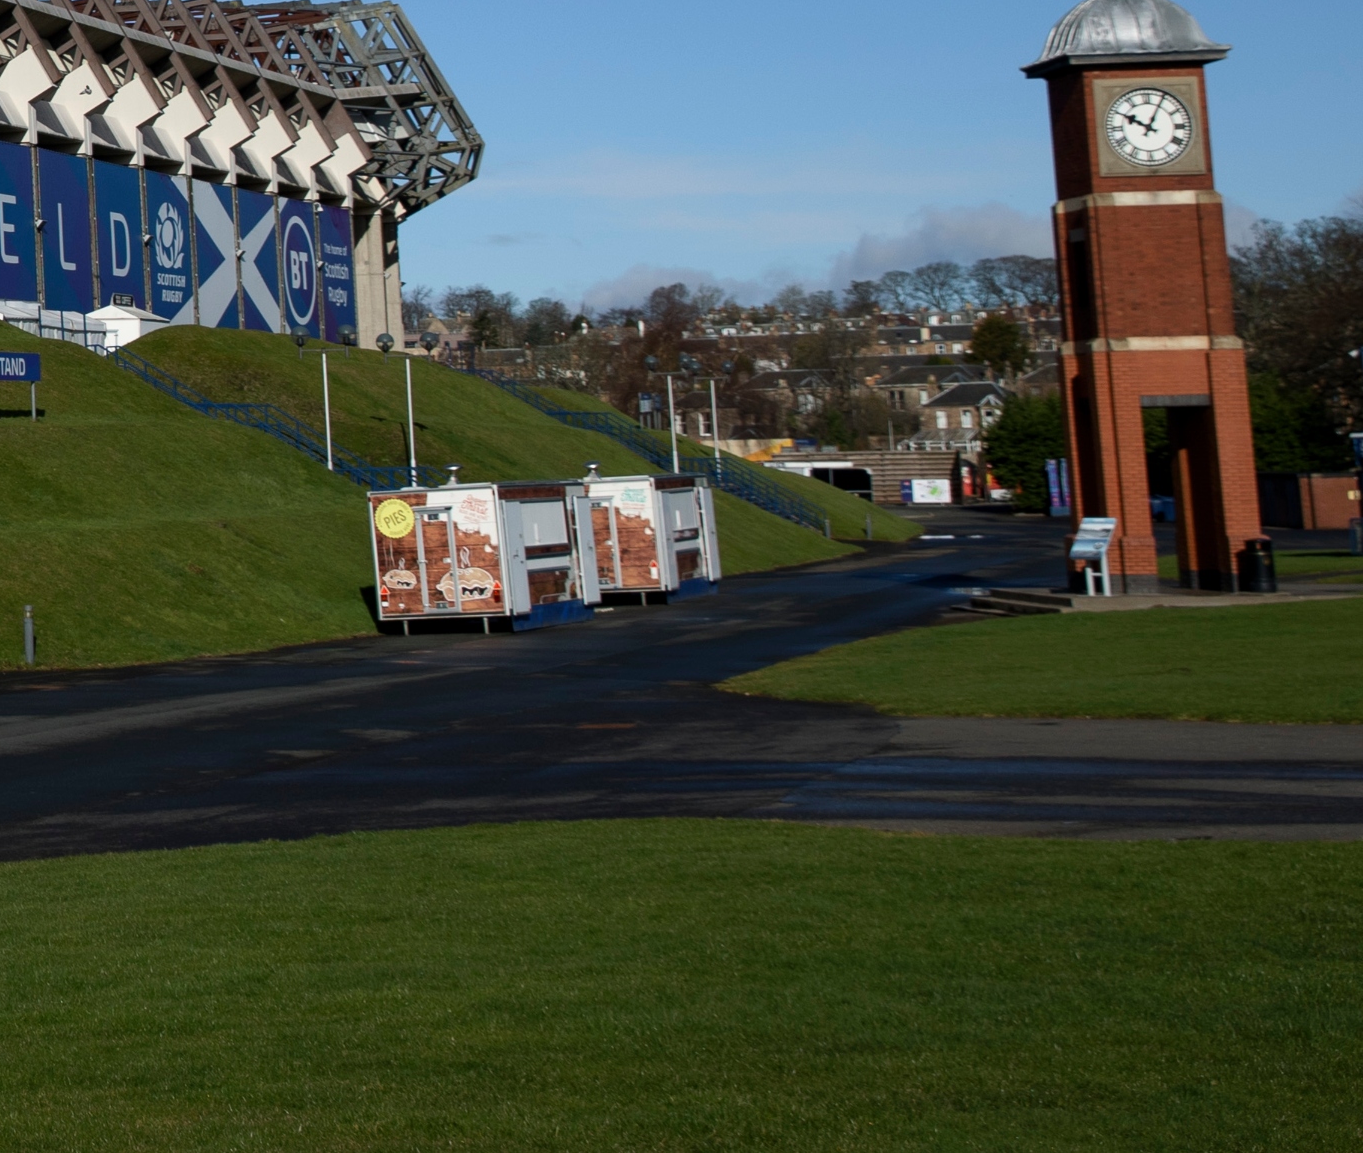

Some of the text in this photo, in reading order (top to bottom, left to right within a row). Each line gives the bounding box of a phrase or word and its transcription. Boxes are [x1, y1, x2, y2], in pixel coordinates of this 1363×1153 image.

[330, 244, 342, 256] home
[342, 245, 348, 256] of
[290, 250, 309, 290] BT
[325, 262, 350, 280] Scottish
[157, 273, 186, 287] SCOTTISH
[162, 289, 183, 303] RUGBY
[328, 286, 348, 307] Rugby
[383, 509, 407, 529] PIES
